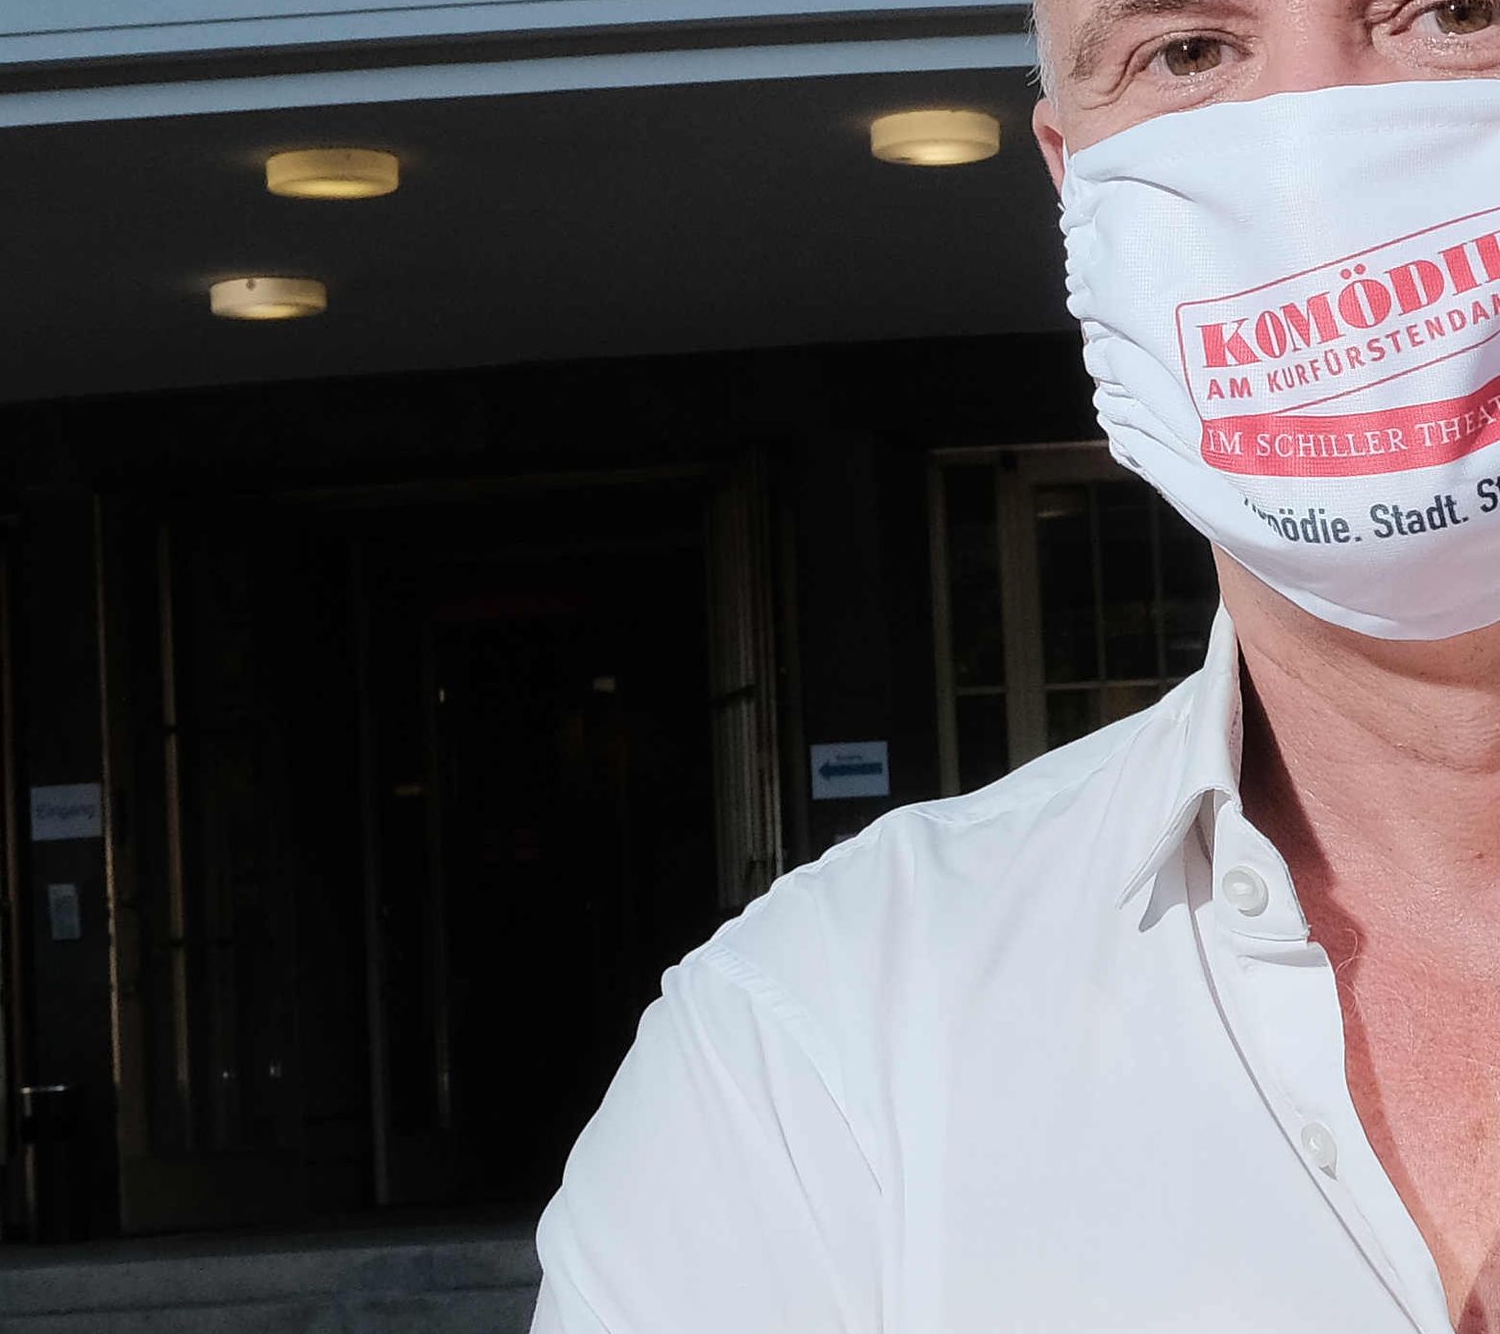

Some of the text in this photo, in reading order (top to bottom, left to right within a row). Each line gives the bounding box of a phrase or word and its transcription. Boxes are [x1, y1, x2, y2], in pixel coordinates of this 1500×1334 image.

[1206, 377, 1253, 400] AM
[1206, 427, 1244, 457] IM
[1256, 426, 1408, 459] SCHILLER
[1244, 498, 1363, 544] ödie.
[1370, 494, 1469, 539] Stadt.
